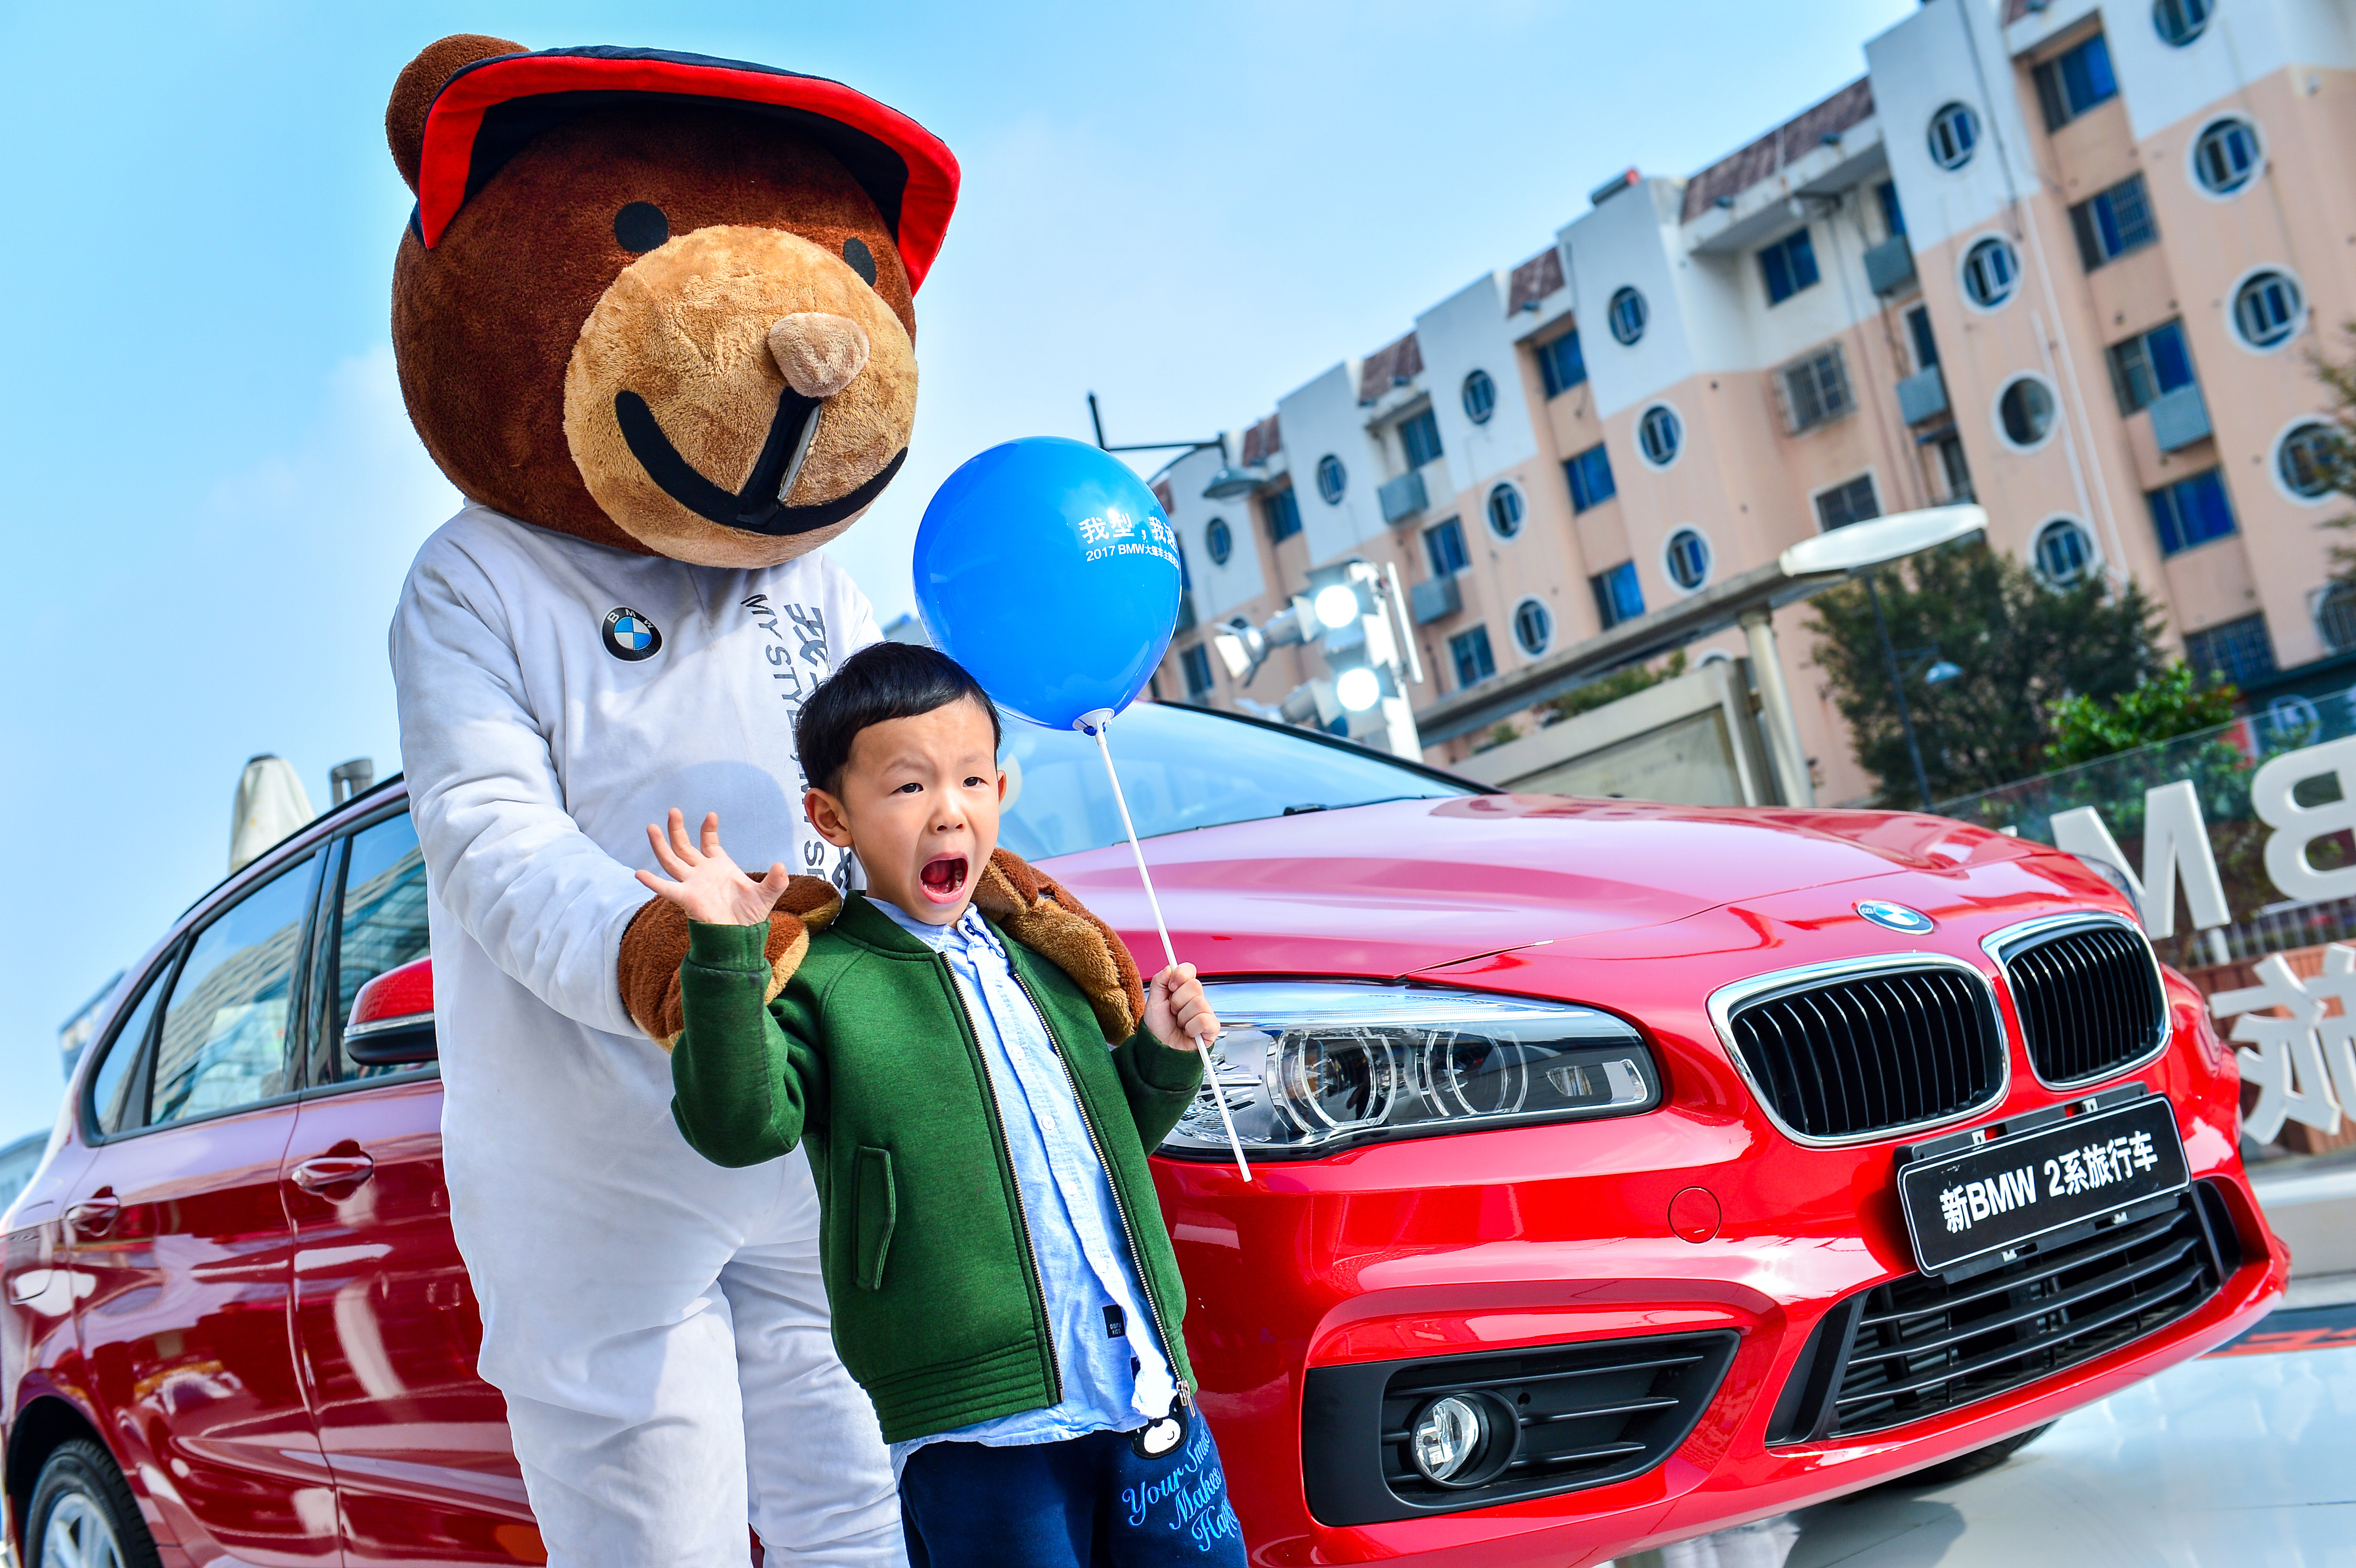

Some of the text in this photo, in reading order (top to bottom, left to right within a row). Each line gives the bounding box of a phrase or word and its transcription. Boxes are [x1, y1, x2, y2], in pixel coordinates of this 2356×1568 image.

[1086, 545, 1115, 562] 2017
[607, 609, 654, 628] BMW
[740, 594, 783, 640] MY
[1939, 1130, 2159, 1234] 新BMW 2系旅行车
[1122, 1467, 1184, 1527] Your
[1169, 1467, 1222, 1531] Makes
